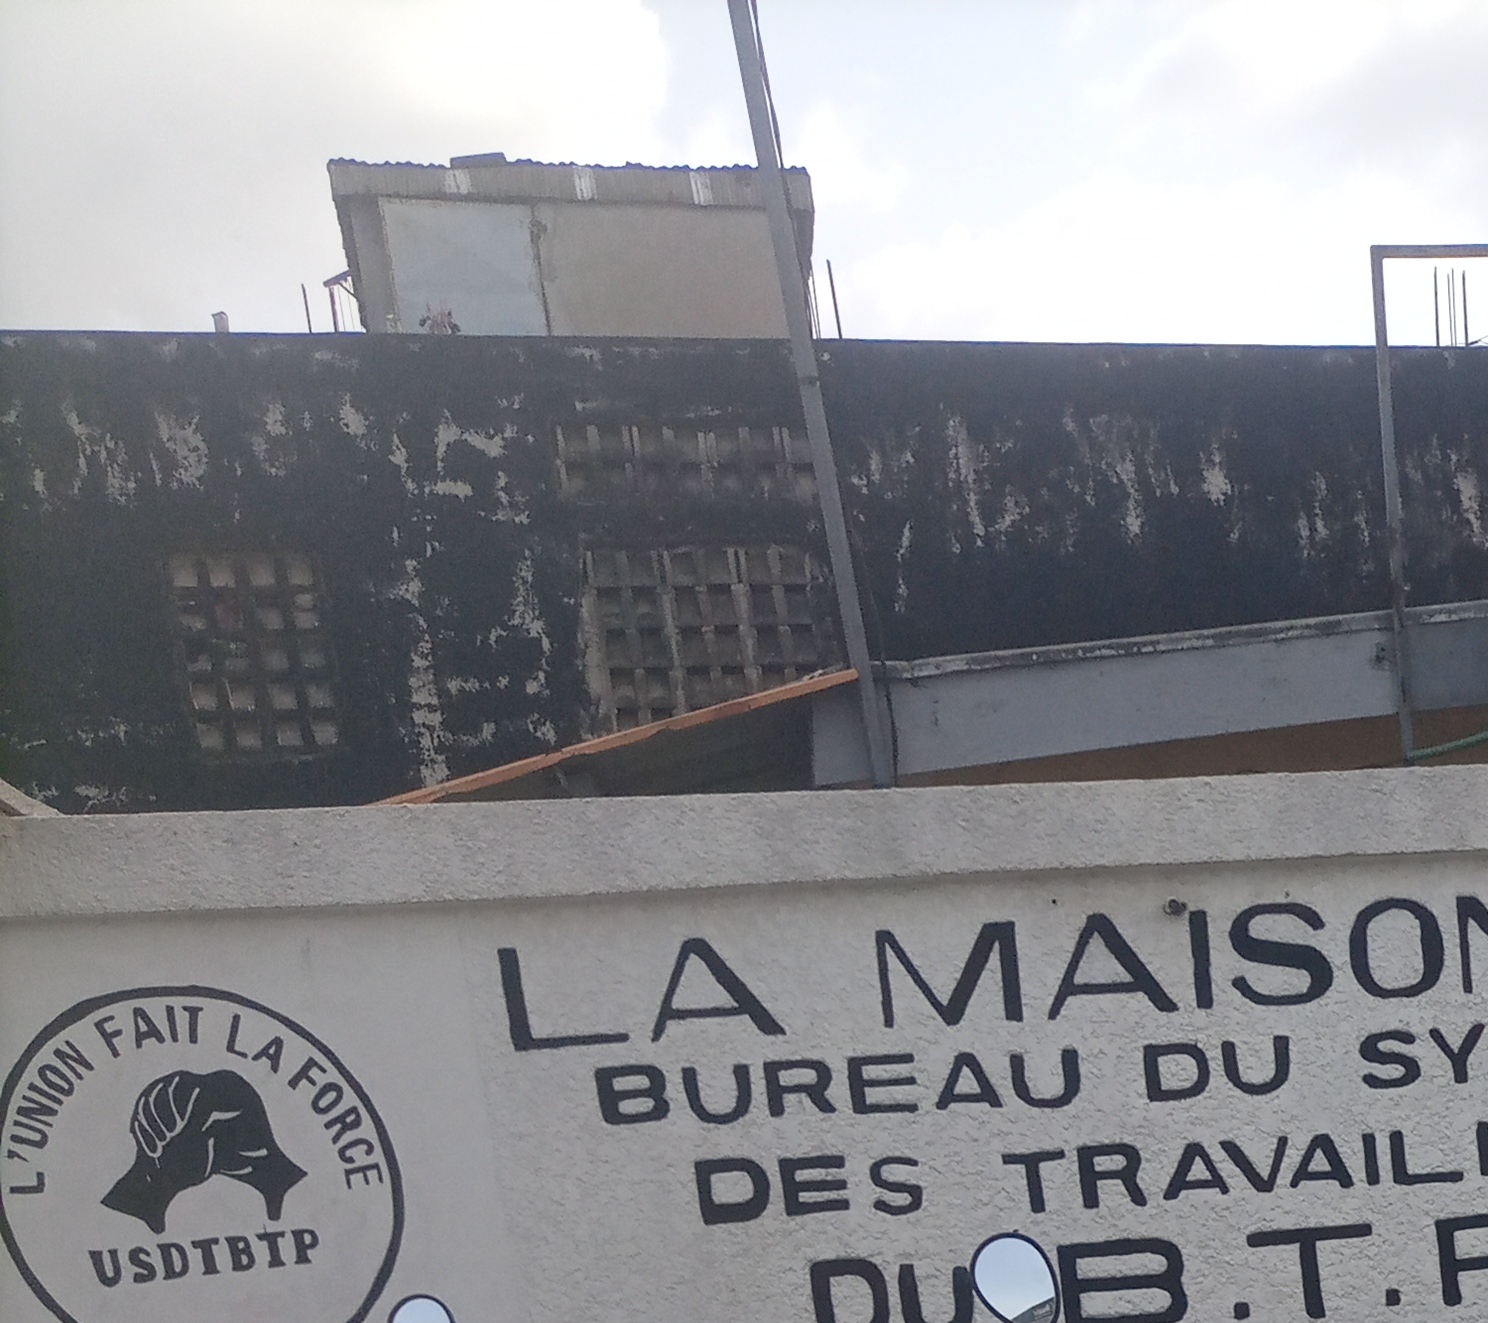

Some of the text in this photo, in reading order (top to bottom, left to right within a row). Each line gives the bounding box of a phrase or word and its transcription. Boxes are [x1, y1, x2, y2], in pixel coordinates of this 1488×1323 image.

[497, 938, 785, 1050] LA
[7, 1005, 384, 1194] L'UNION FAIT LA FORCE
[594, 1047, 1081, 1124] BUREAU
[1144, 1035, 1290, 1102] DU
[694, 1155, 924, 1225] DES
[88, 1228, 320, 1288] USDTBTP
